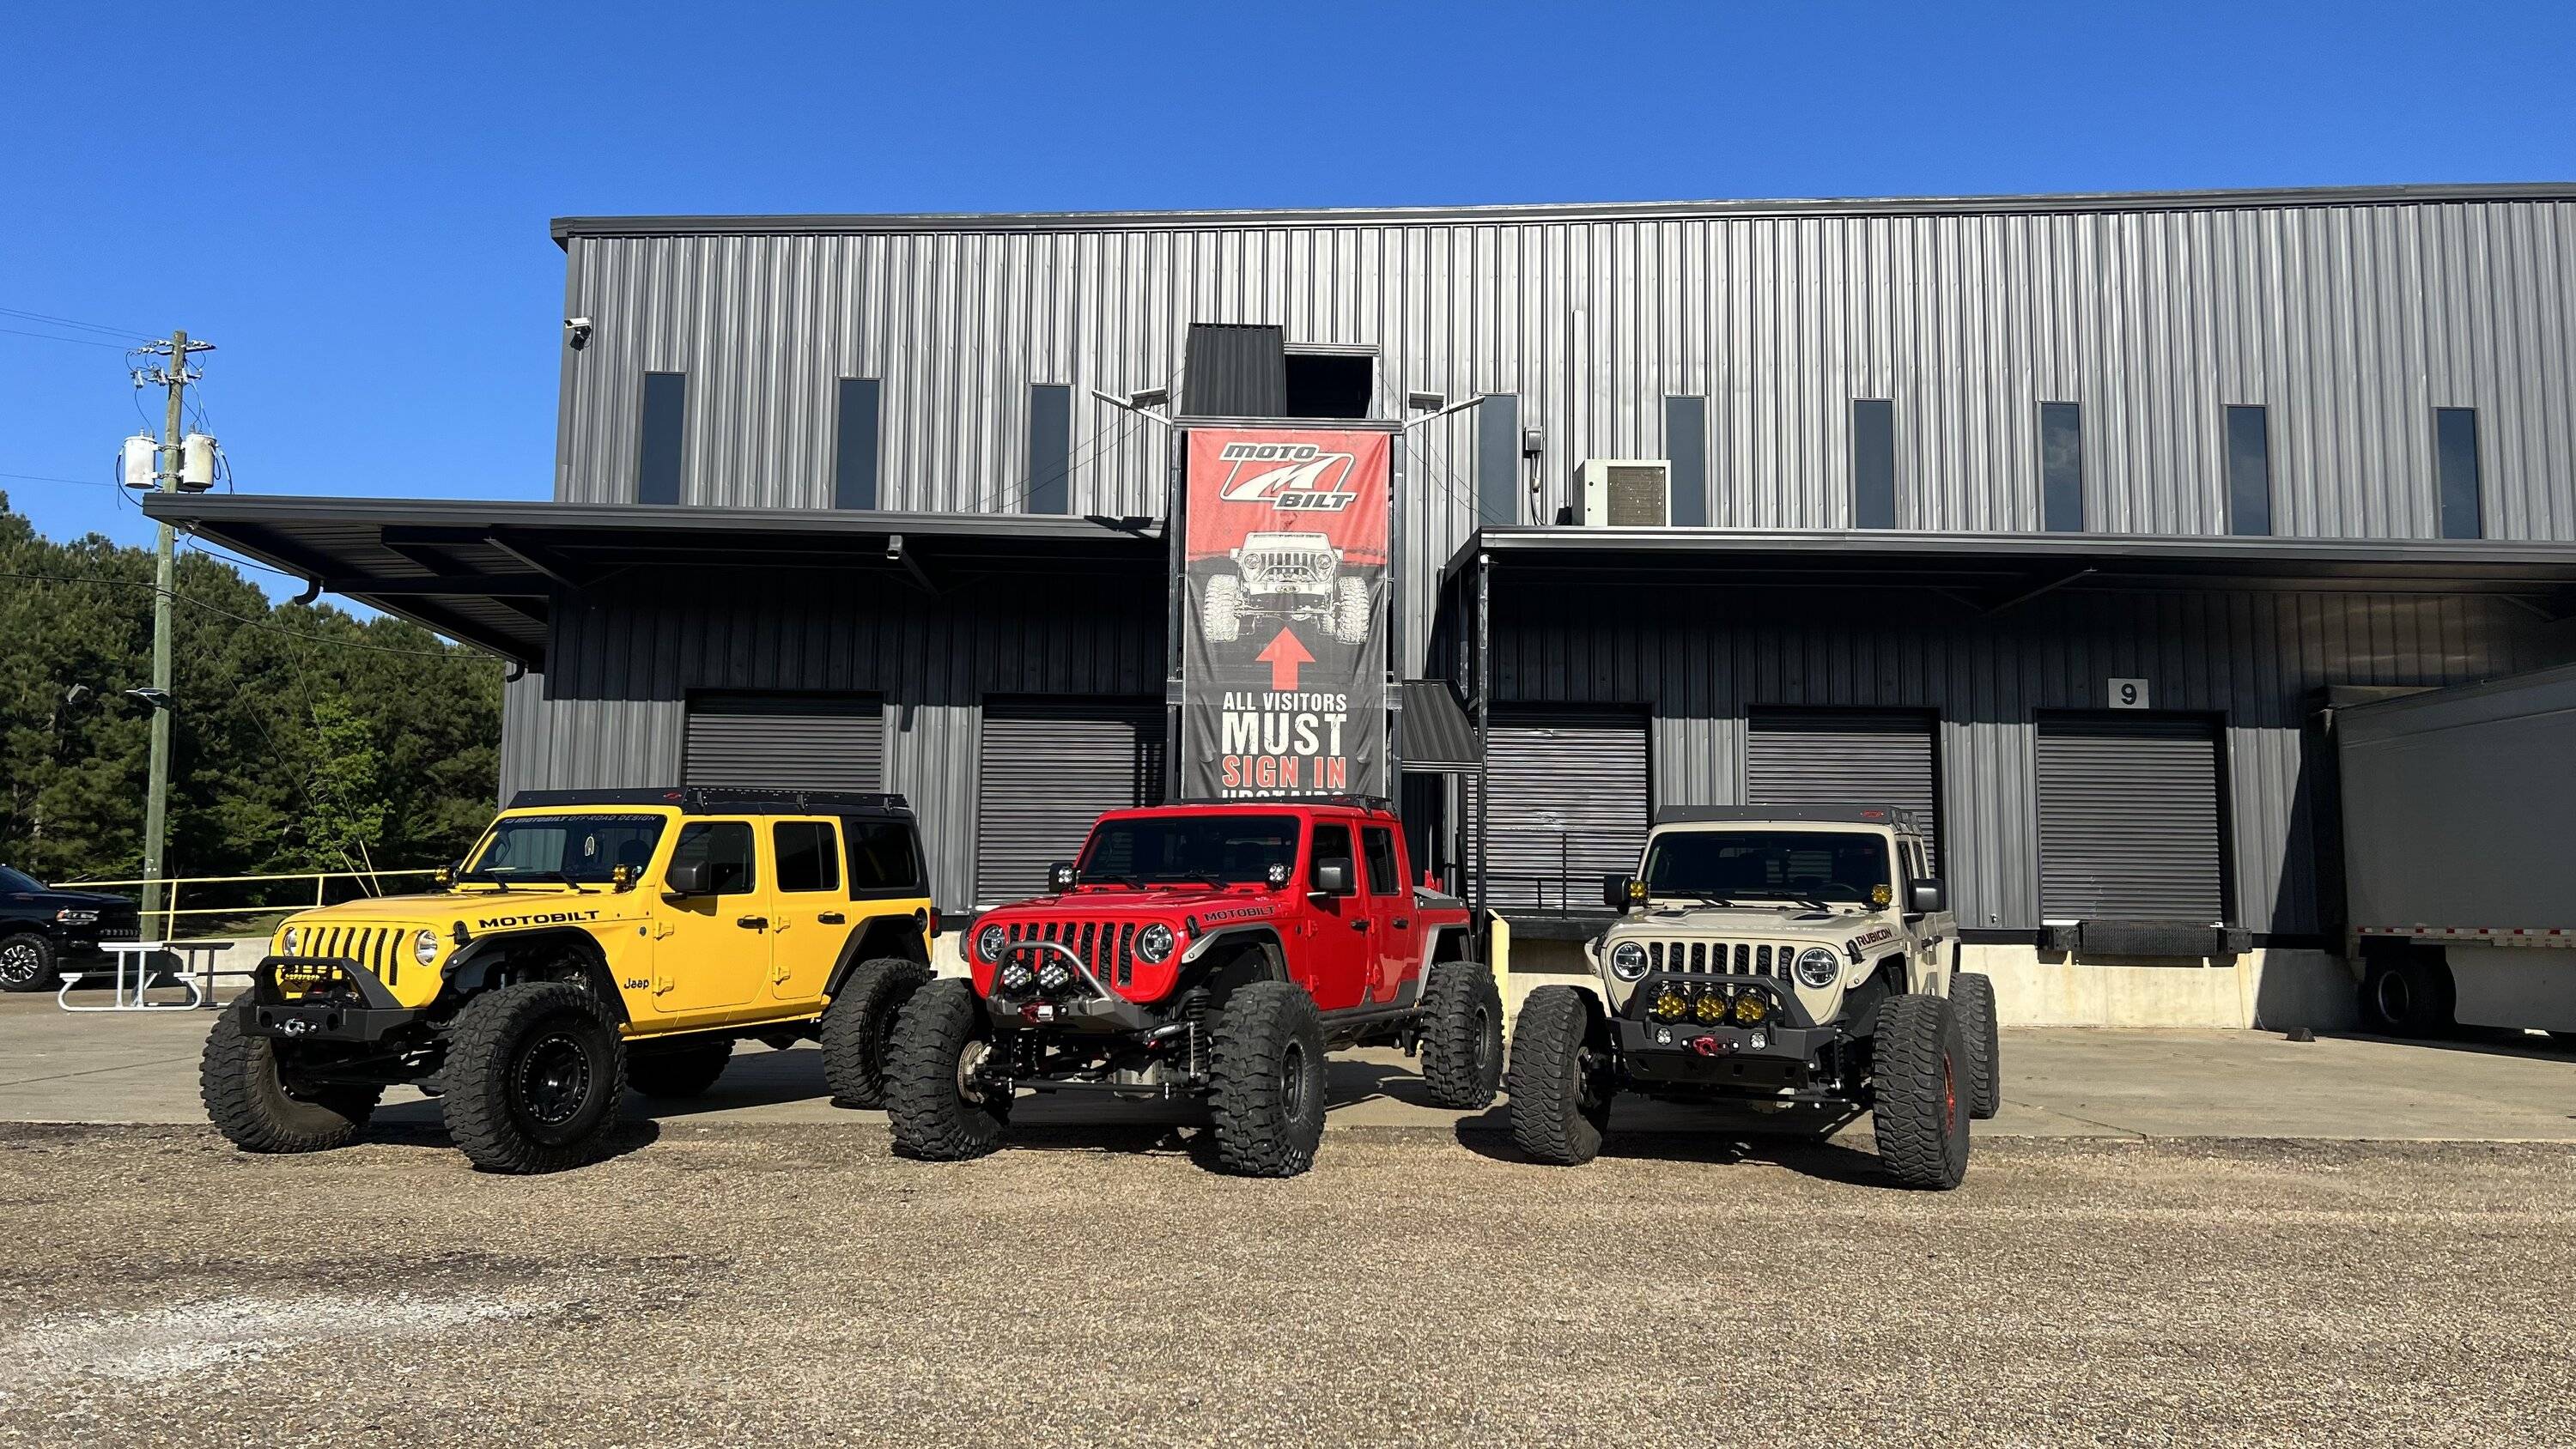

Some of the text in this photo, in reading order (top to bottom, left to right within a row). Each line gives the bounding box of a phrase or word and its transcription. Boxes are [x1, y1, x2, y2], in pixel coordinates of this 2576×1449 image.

[1224, 445, 1317, 459] MOTO
[1276, 494, 1353, 508] BILT
[1223, 691, 1347, 712] ALL VISITORS
[2121, 683, 2137, 705] 9
[1221, 712, 1347, 755] MUST
[1222, 755, 1346, 789] SIGN IN
[478, 910, 600, 929] MOTOBILT
[1204, 906, 1275, 922] MOTOBILT
[1855, 927, 1893, 947] RUBICON
[623, 977, 650, 991] Jeep
